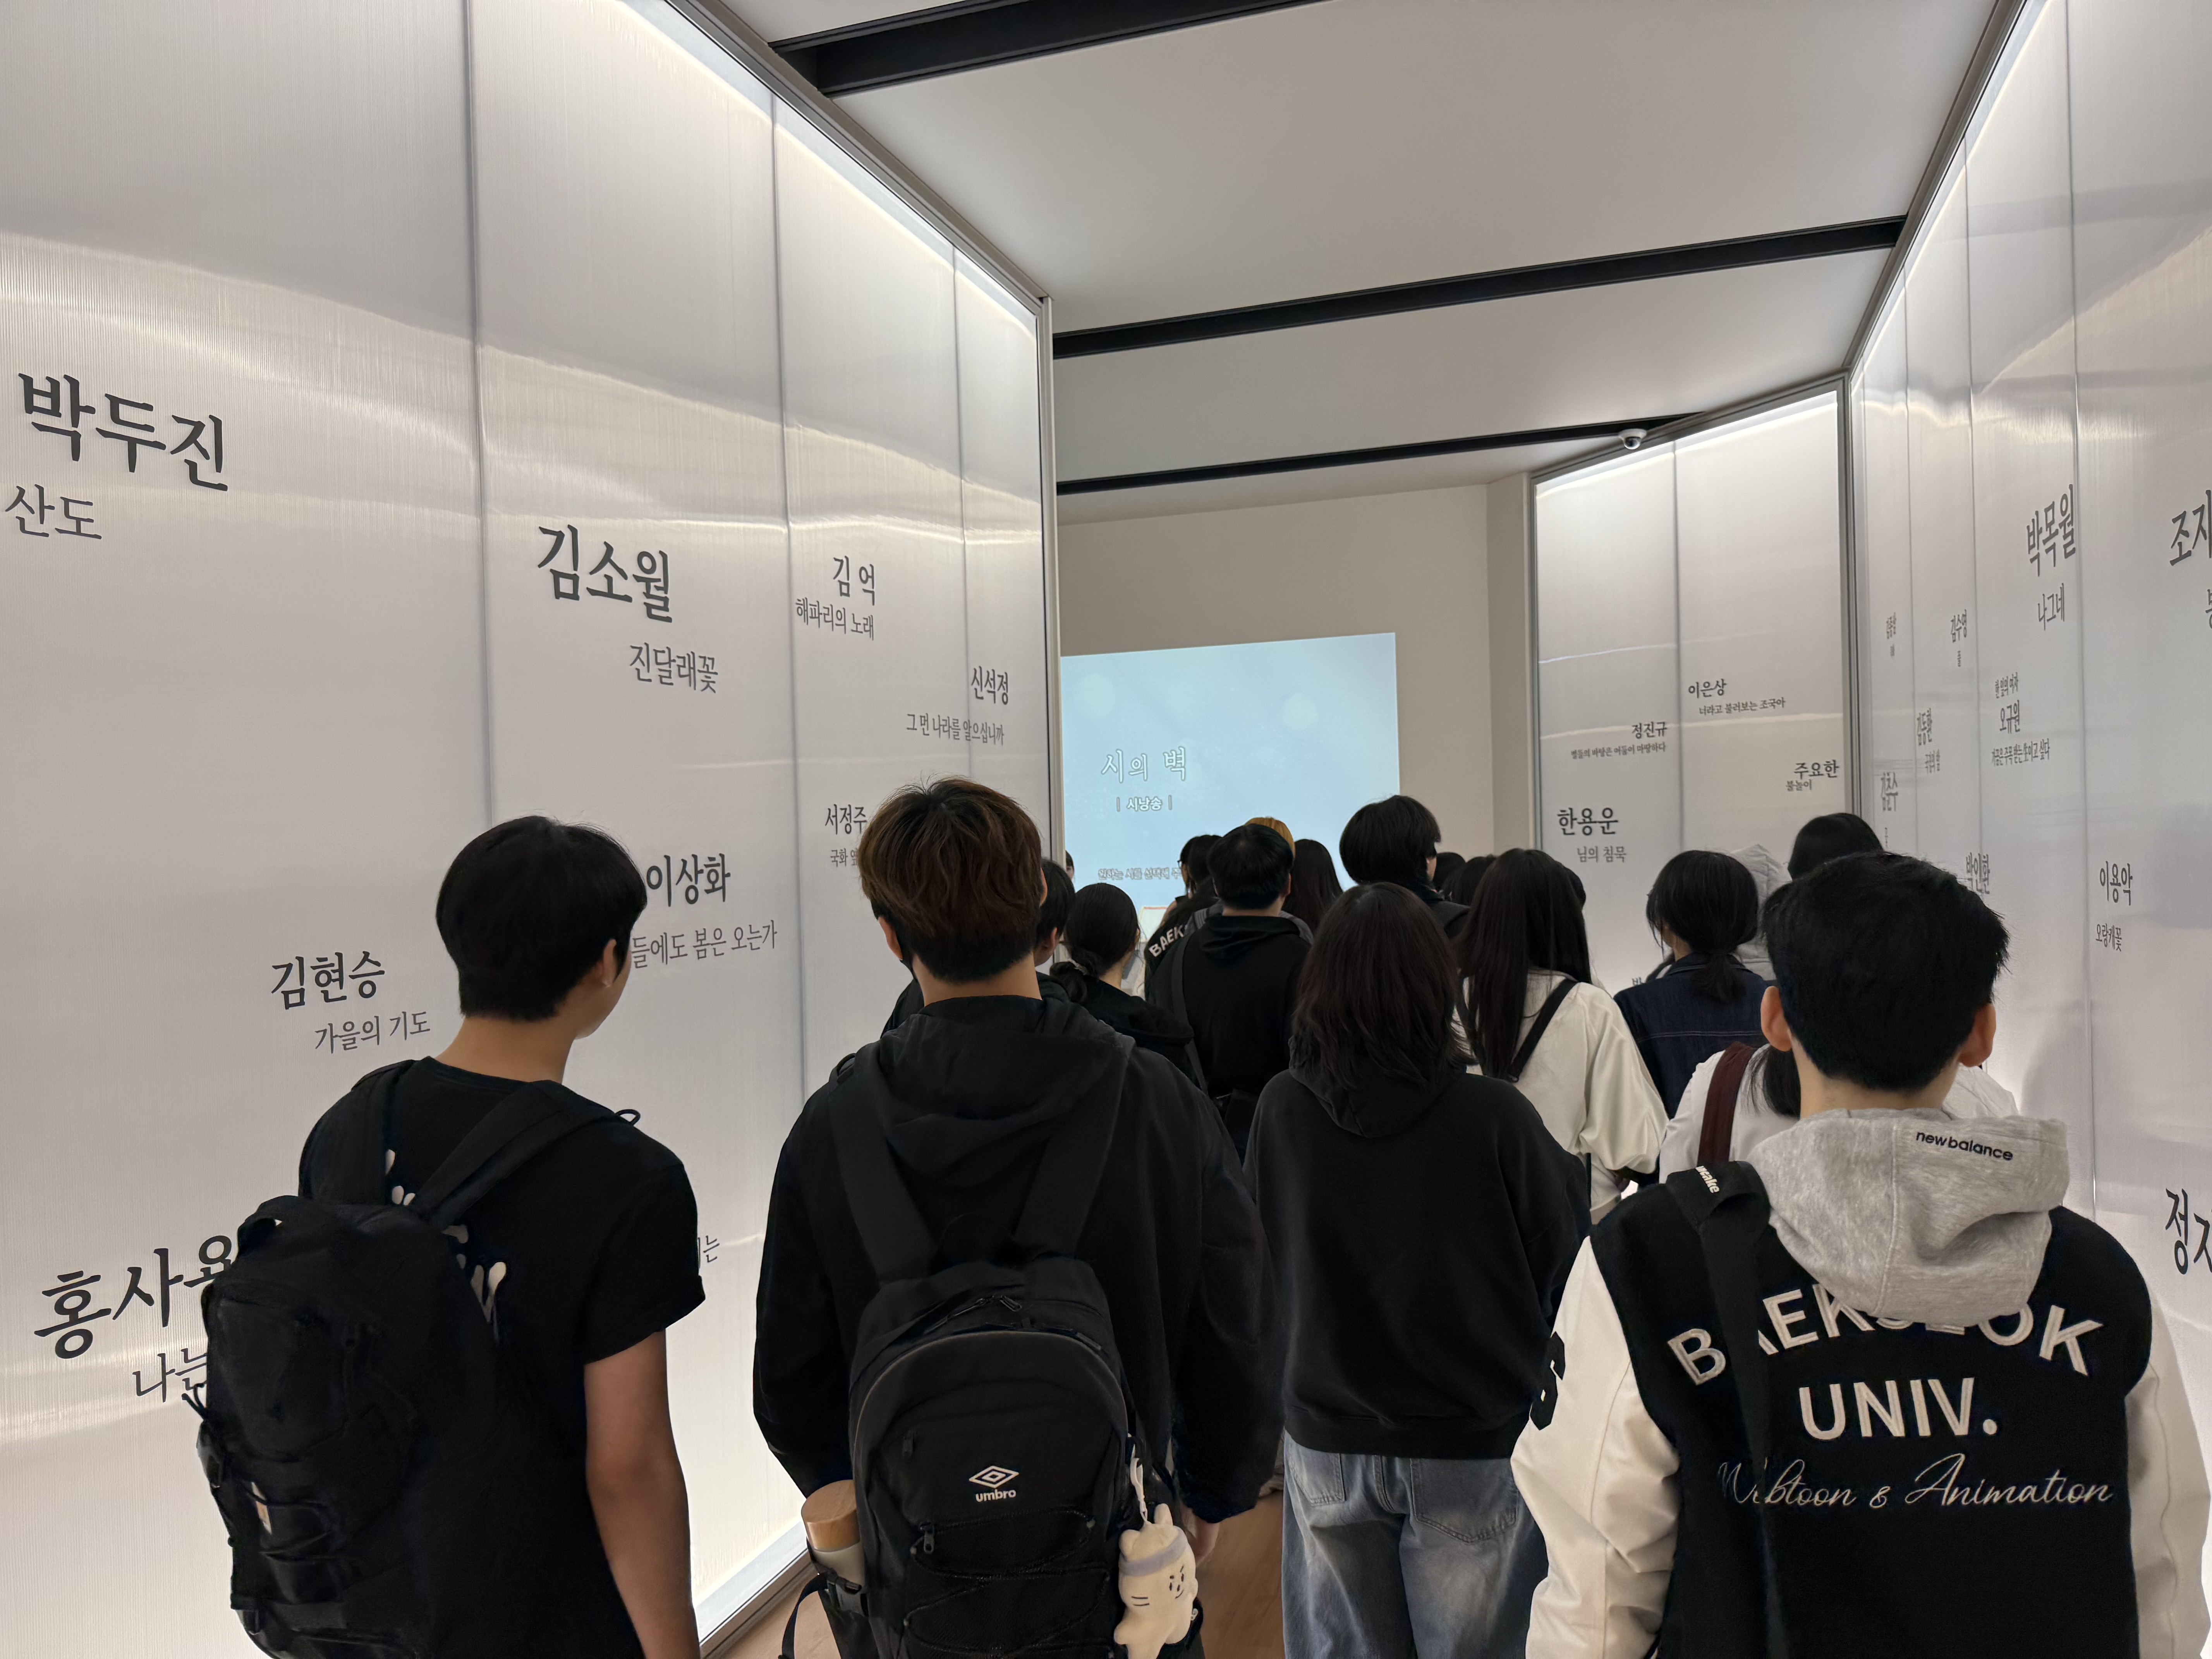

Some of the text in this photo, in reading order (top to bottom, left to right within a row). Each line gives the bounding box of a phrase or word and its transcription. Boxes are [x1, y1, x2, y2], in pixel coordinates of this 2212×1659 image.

[18, 373, 228, 491] 박두진
[5, 484, 102, 539] 산도
[2027, 484, 2076, 577] 박목월
[538, 524, 672, 623] 김소월
[833, 555, 875, 606] 김 억
[795, 597, 874, 641] 해파리의 노래
[1951, 609, 1967, 643] 김수영
[2038, 583, 2064, 631] 나그네
[630, 642, 718, 693] 진달래꽃
[971, 666, 1008, 705] 신석정
[1688, 678, 1726, 699] 이은상
[1699, 697, 1786, 715] 너라고 불러보는 조국아
[907, 714, 917, 731] 그
[919, 713, 929, 736] 먼
[933, 715, 961, 740] 나라를
[1632, 721, 1668, 739] 정진규
[2000, 700, 2020, 734] 오규원
[1101, 746, 1186, 783] 시의 벽
[1637, 742, 1666, 754] 마땅하다
[1786, 779, 1812, 792] 불놀이
[1794, 760, 1839, 779] 주요한
[825, 804, 867, 835] 서정주
[1126, 796, 1163, 812] 시낭송
[1557, 807, 1618, 836] 한용운
[830, 848, 848, 867] 국화
[1577, 847, 1626, 864] 님의 침묵
[1966, 852, 1990, 895] 박인환
[646, 853, 731, 907] 이상화
[2100, 861, 2133, 905] 이용악
[631, 920, 777, 968] 들에도 봄은 오는가
[2095, 923, 2122, 951] 오랑캐꽃
[271, 951, 385, 1010] 김현승
[315, 1011, 430, 1054] 가을의 기도
[1668, 1283, 2103, 1385] BEKOK
[132, 1348, 208, 1403] 나는
[1799, 1377, 1999, 1441] UNIV.
[975, 1489, 1016, 1502] umbro
[1905, 1453, 2112, 1506] Animation
